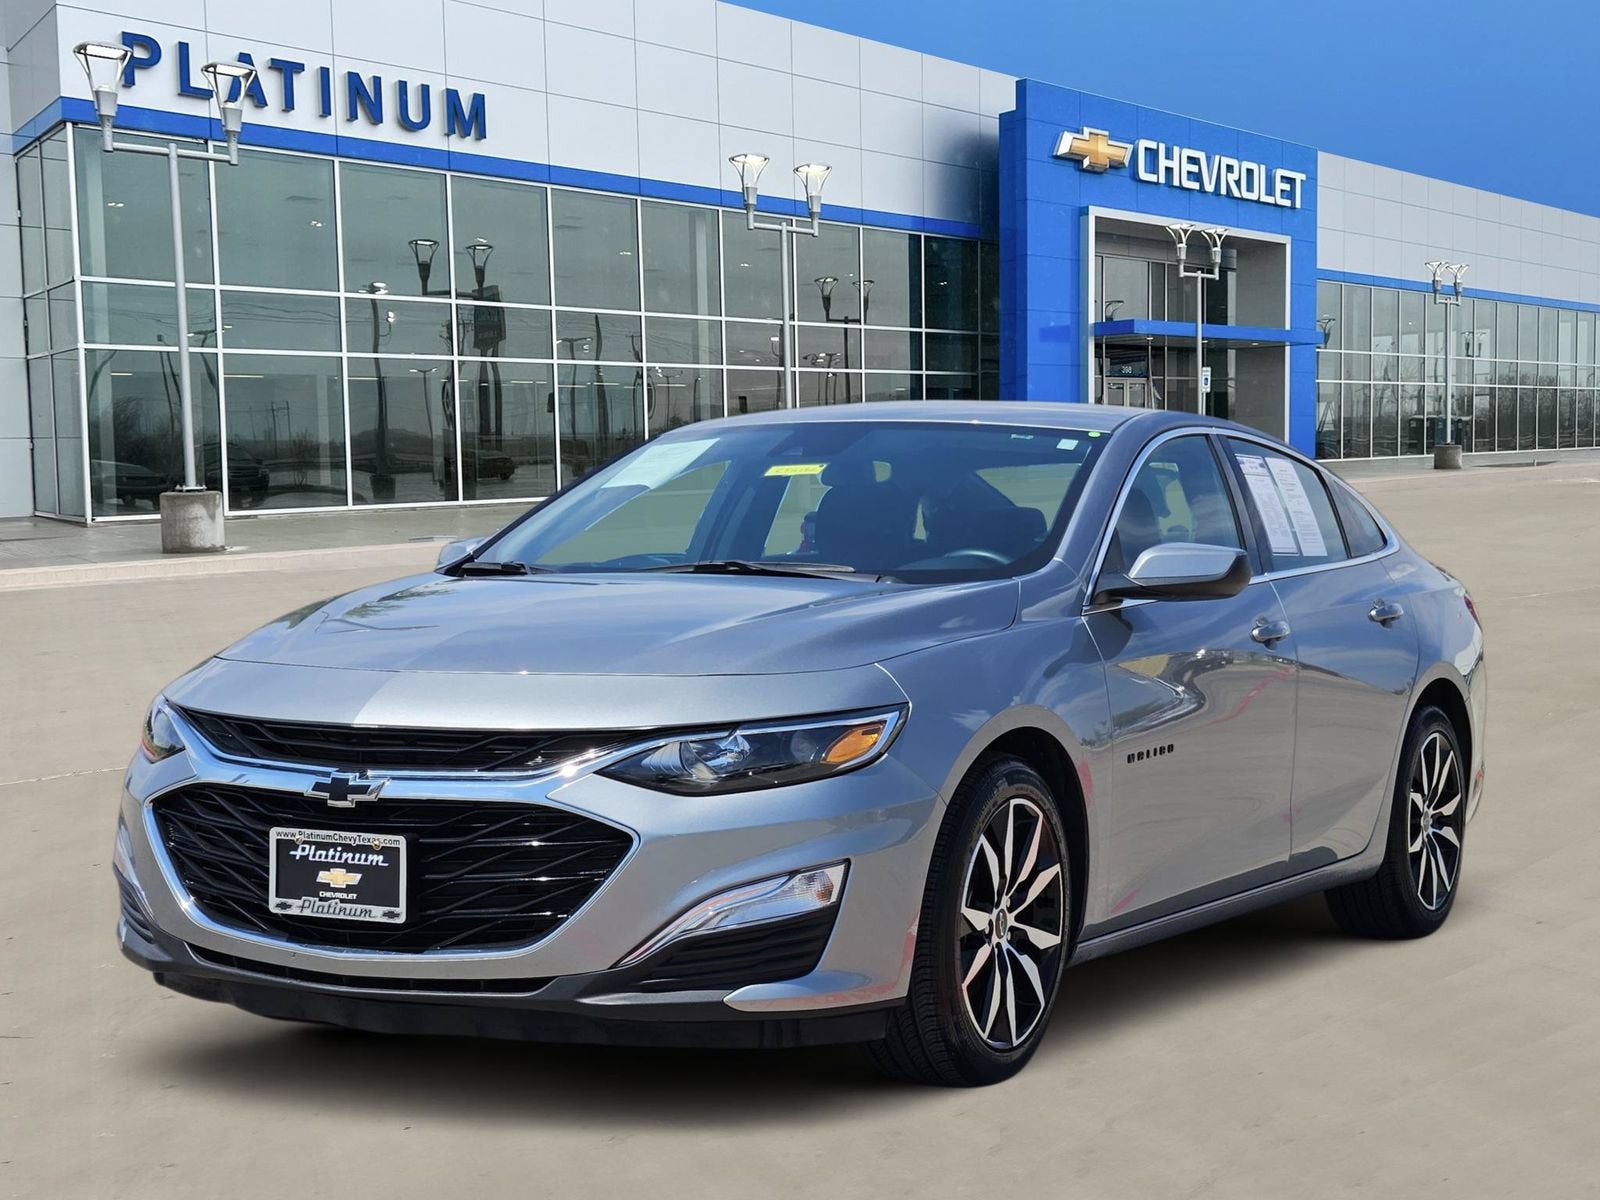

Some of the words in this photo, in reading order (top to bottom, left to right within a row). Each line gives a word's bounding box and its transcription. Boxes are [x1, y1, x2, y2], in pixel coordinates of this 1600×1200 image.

[121, 31, 487, 141] PLATINUM
[1136, 139, 1307, 209] CHEVROLET
[275, 830, 401, 846] wwwPlatinumChevyTexas.com
[289, 844, 389, 867] Platinum
[319, 891, 358, 900] CHEVROLET
[296, 899, 378, 919] Platinum
